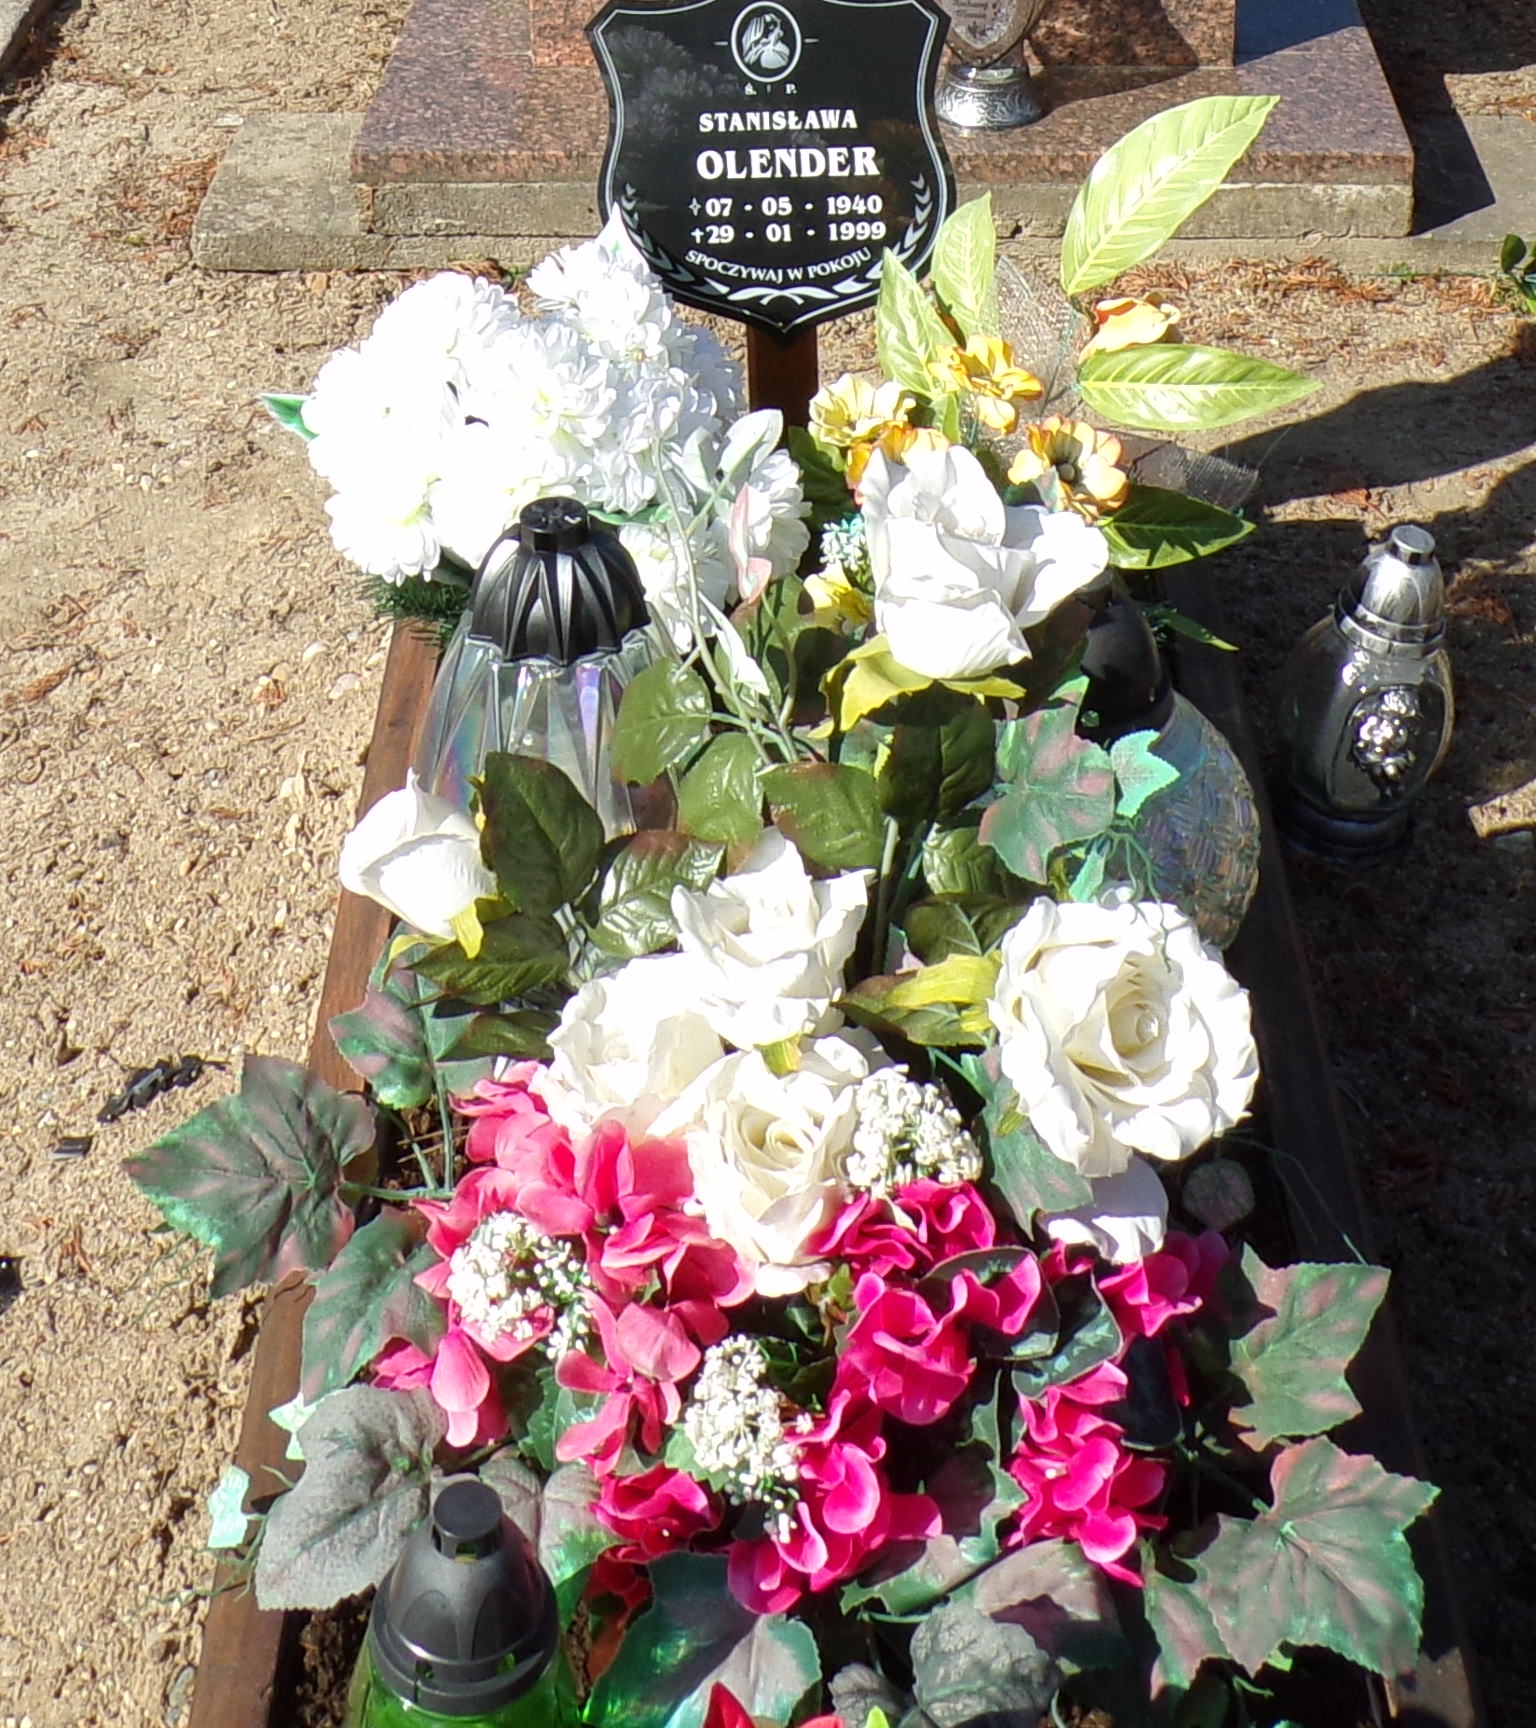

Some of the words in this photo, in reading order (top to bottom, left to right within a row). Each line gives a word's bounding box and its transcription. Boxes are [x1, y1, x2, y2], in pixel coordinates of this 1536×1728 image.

[785, 83, 798, 95] P.
[699, 109, 858, 133] STANISŁAWA
[696, 145, 880, 180] OLENDER
[705, 198, 733, 217] 07
[761, 197, 792, 216] 05
[827, 194, 883, 215] 1940
[705, 225, 735, 244] 29
[766, 223, 792, 242] 01
[828, 221, 886, 241] 1999
[685, 248, 784, 284] SPOCZYWAJ
[787, 267, 804, 281] W
[808, 246, 872, 279] POKOJU
